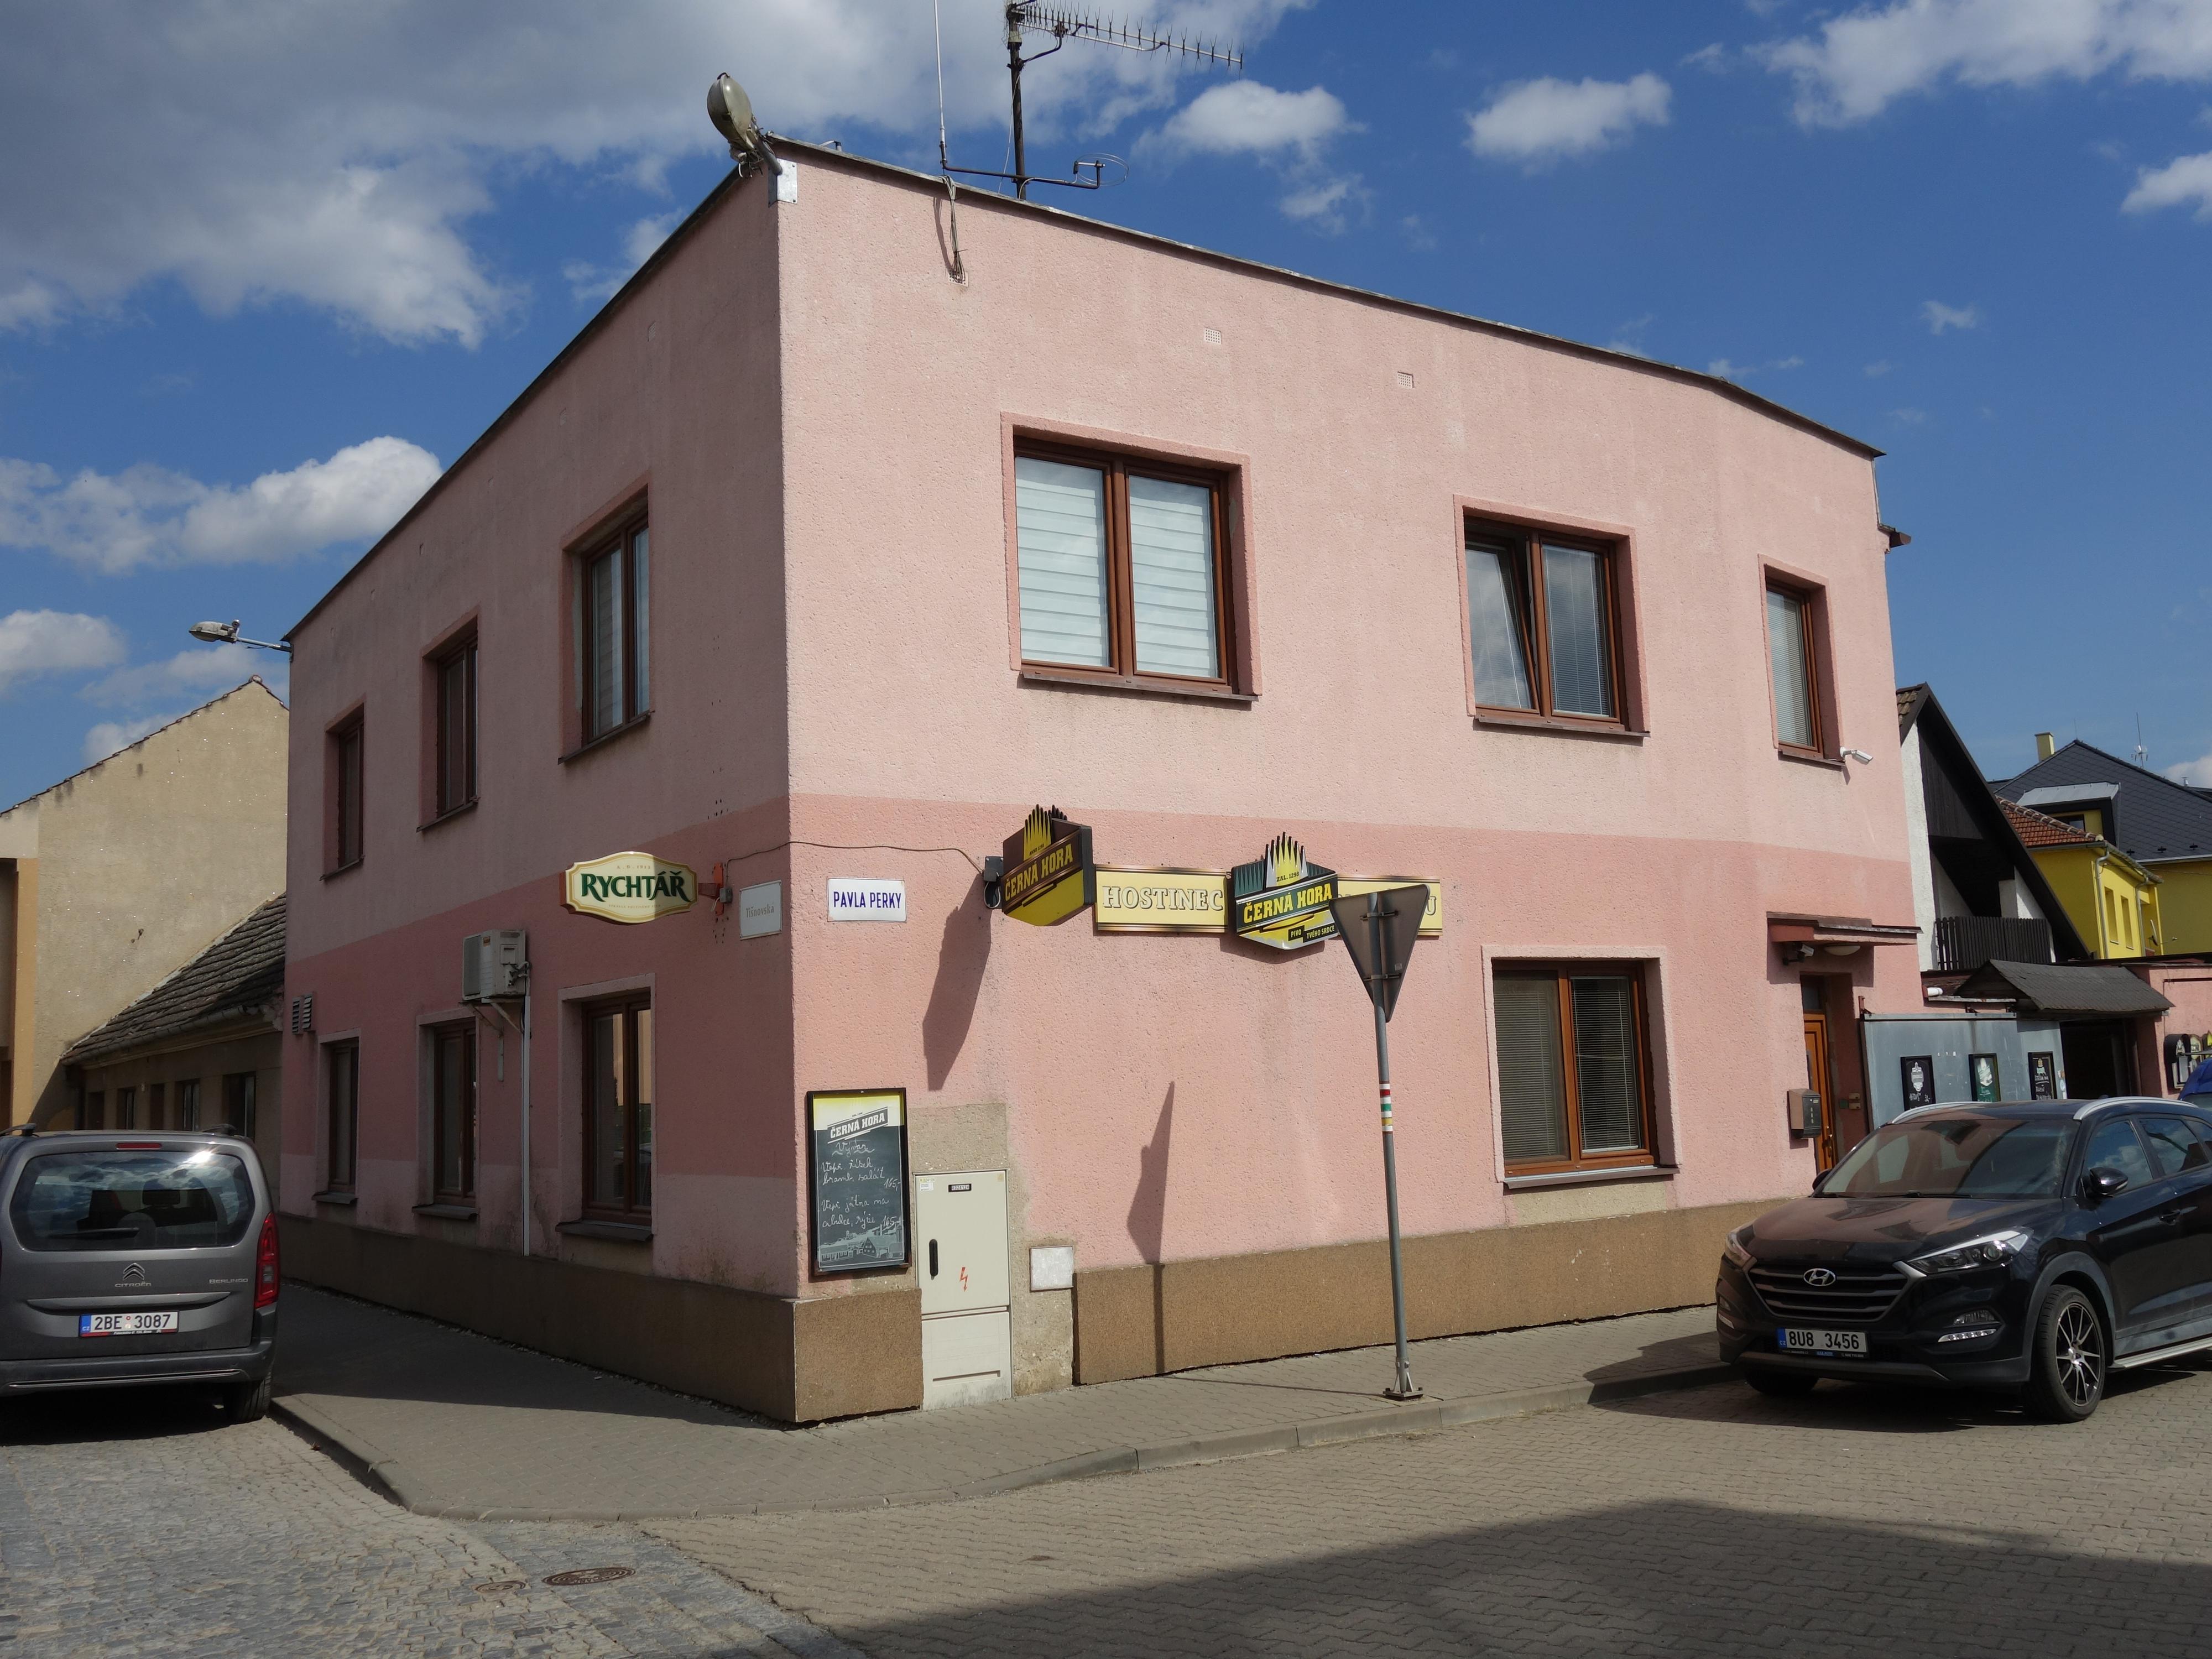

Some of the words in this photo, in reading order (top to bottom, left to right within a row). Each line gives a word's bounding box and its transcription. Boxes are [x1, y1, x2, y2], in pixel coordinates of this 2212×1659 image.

[1005, 860, 1039, 901] ČERNÁ
[1041, 843, 1073, 878] HORA
[581, 871, 691, 902] RYCHTÁŘ
[833, 891, 866, 908] PAVLA
[869, 892, 902, 909] PERKY
[1102, 886, 1224, 911] HOSTINEC
[1244, 892, 1293, 924] ČERNÁ
[1297, 883, 1332, 909] HORA
[745, 902, 775, 919] Tišnovská
[1291, 929, 1302, 938] PIVO
[1306, 930, 1321, 940] TVÉHO
[1321, 925, 1335, 935] SRDCE
[830, 1119, 860, 1139] ČERNÁ
[861, 1112, 885, 1129] HORA
[94, 1316, 122, 1331] 2BE
[134, 1314, 171, 1329] 3087
[1788, 1331, 1814, 1347] 8U8
[1824, 1333, 1860, 1349] 3456
